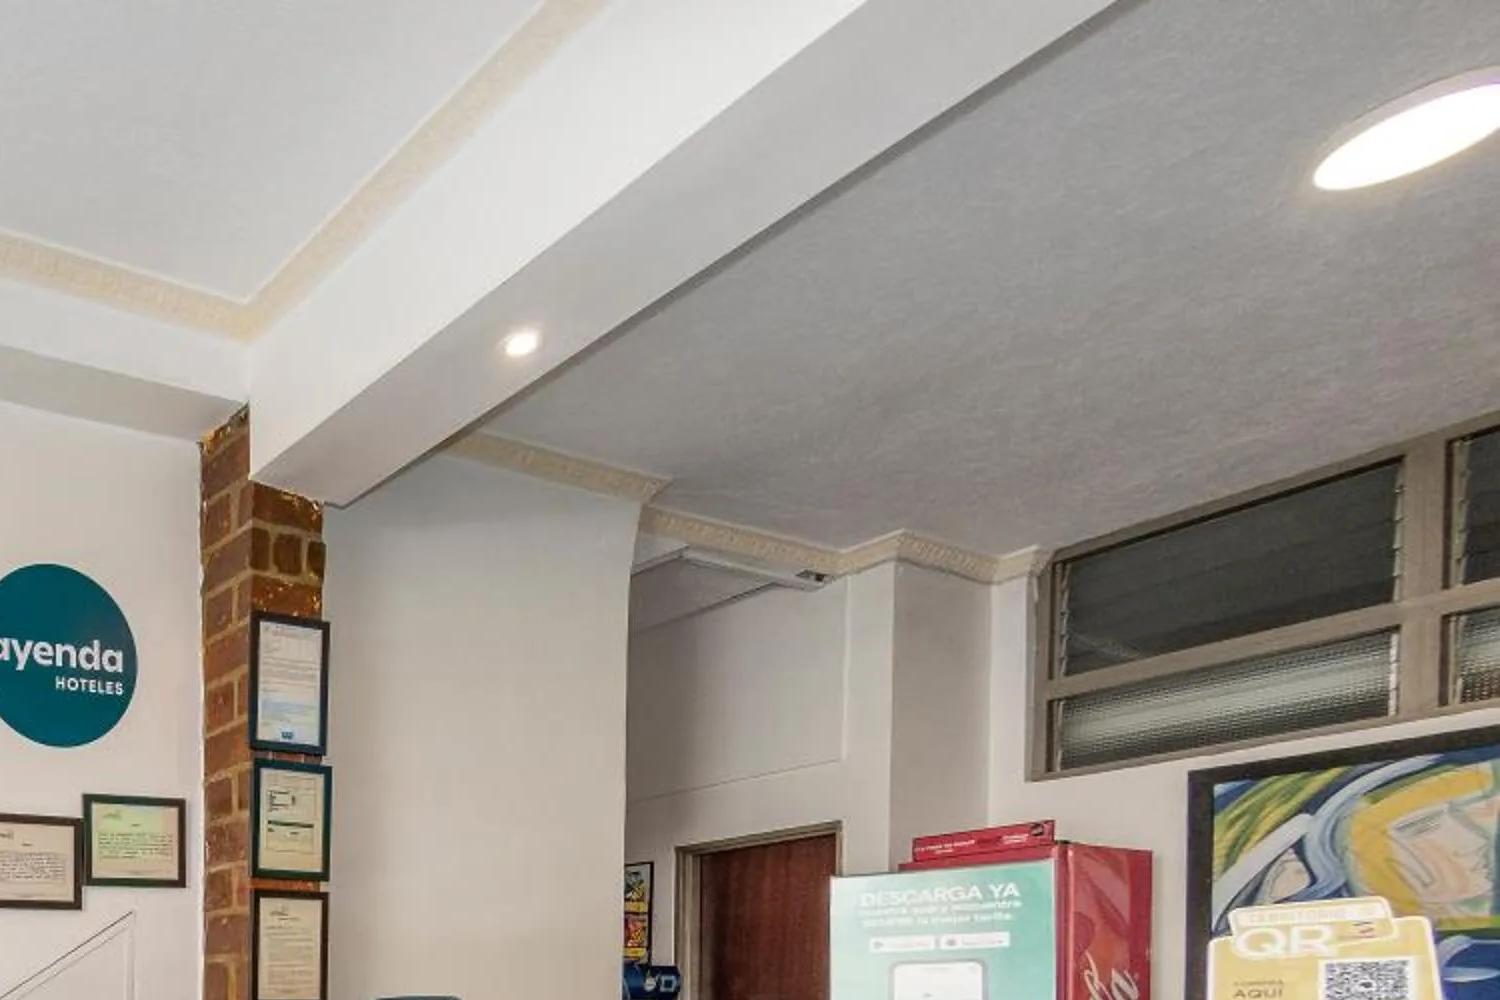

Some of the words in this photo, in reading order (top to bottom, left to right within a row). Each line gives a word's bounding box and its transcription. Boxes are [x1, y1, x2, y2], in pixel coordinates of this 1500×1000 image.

[55, 675, 125, 696] HOTELES
[859, 884, 983, 907] DESCARGA
[989, 882, 1021, 899] YA
[1235, 924, 1338, 961] QR
